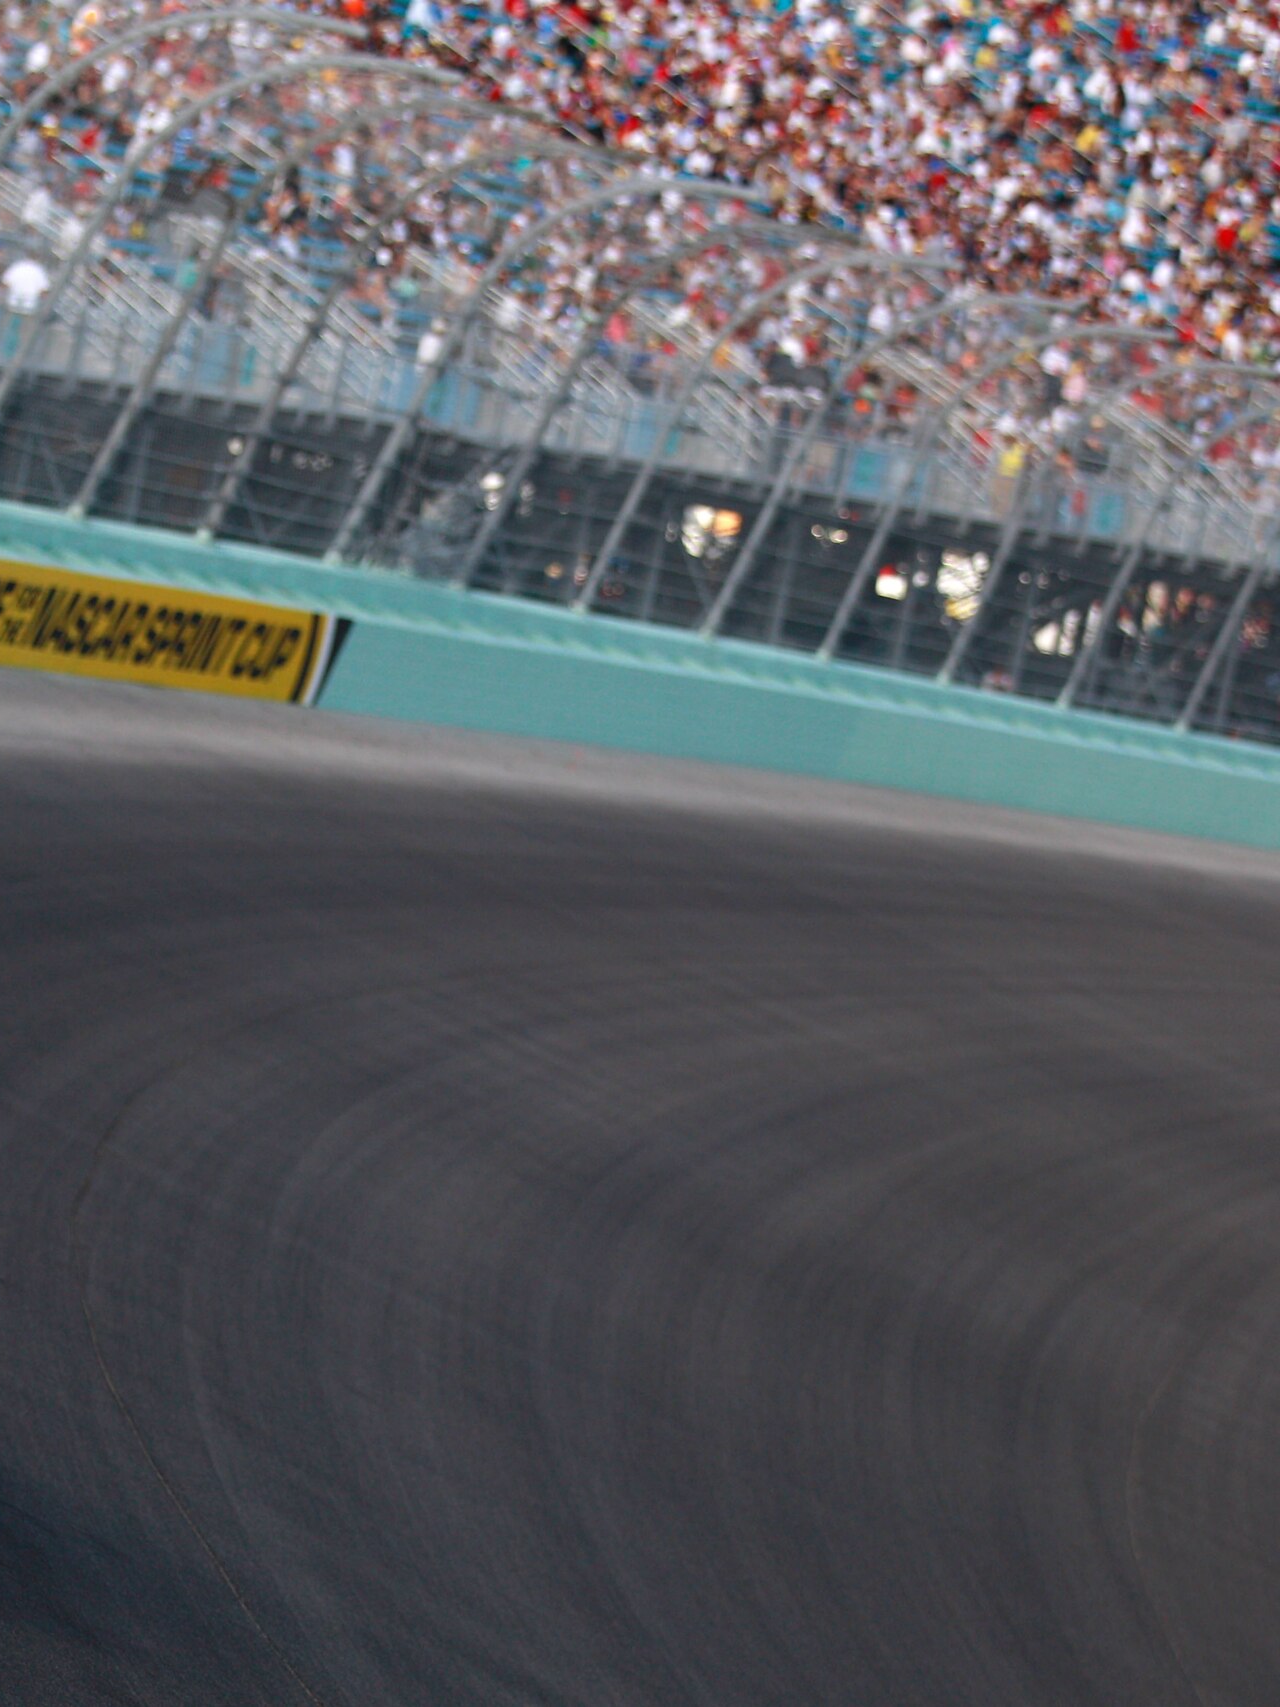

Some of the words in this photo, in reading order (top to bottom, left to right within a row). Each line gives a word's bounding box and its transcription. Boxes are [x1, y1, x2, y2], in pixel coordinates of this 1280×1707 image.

[24, 586, 150, 664] NASCAR
[133, 602, 246, 674] SPRINT
[229, 621, 301, 682] CUP
